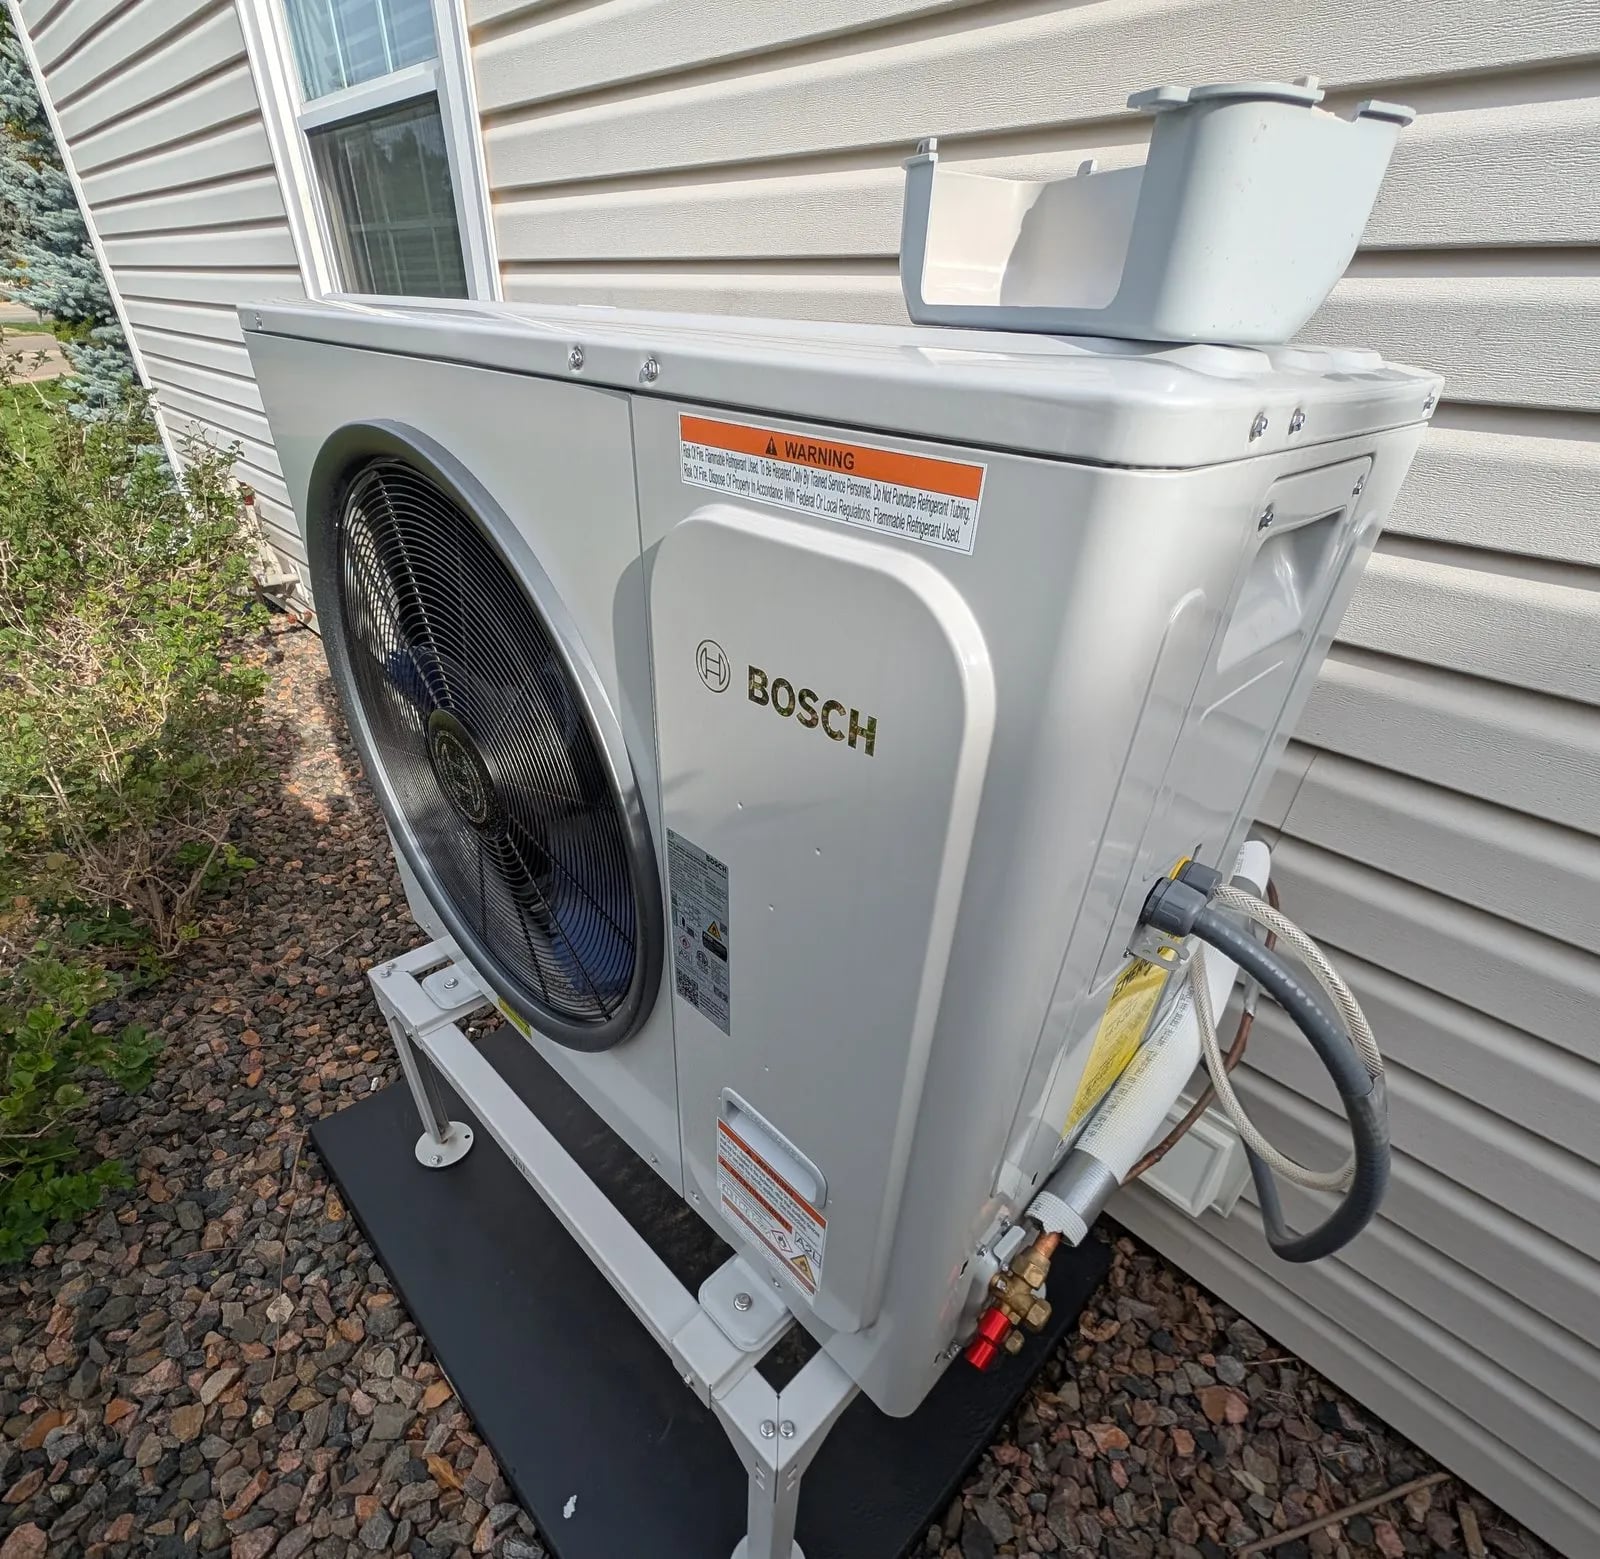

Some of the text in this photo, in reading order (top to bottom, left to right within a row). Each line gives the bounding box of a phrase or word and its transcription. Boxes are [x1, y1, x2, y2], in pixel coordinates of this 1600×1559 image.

[705, 449, 725, 467] Flammable
[726, 453, 746, 473] Refrigerant
[749, 457, 759, 474] Used.
[760, 460, 765, 476] To
[766, 461, 771, 477] Be
[772, 462, 791, 483] Repaired
[803, 468, 809, 489] By
[810, 470, 828, 489] Trained
[828, 473, 846, 493] Service
[847, 477, 873, 499] Personnel.
[873, 483, 882, 501] Do
[882, 484, 892, 503] Not
[892, 486, 916, 509] Puncture
[917, 492, 949, 517] Refrigerant
[949, 498, 971, 524] Tubing.
[784, 440, 855, 471] WARNING
[709, 468, 725, 488] Dispose
[756, 479, 783, 500] Accordance
[796, 488, 815, 508] Federal
[816, 493, 823, 510] Or
[823, 494, 837, 513] Local
[838, 498, 872, 522] Regulations.
[872, 506, 905, 530] Flammable
[906, 513, 941, 539] Refrigerant
[941, 521, 961, 543] Used.
[748, 664, 878, 758] BOSCH
[705, 854, 727, 874] BOSCH
